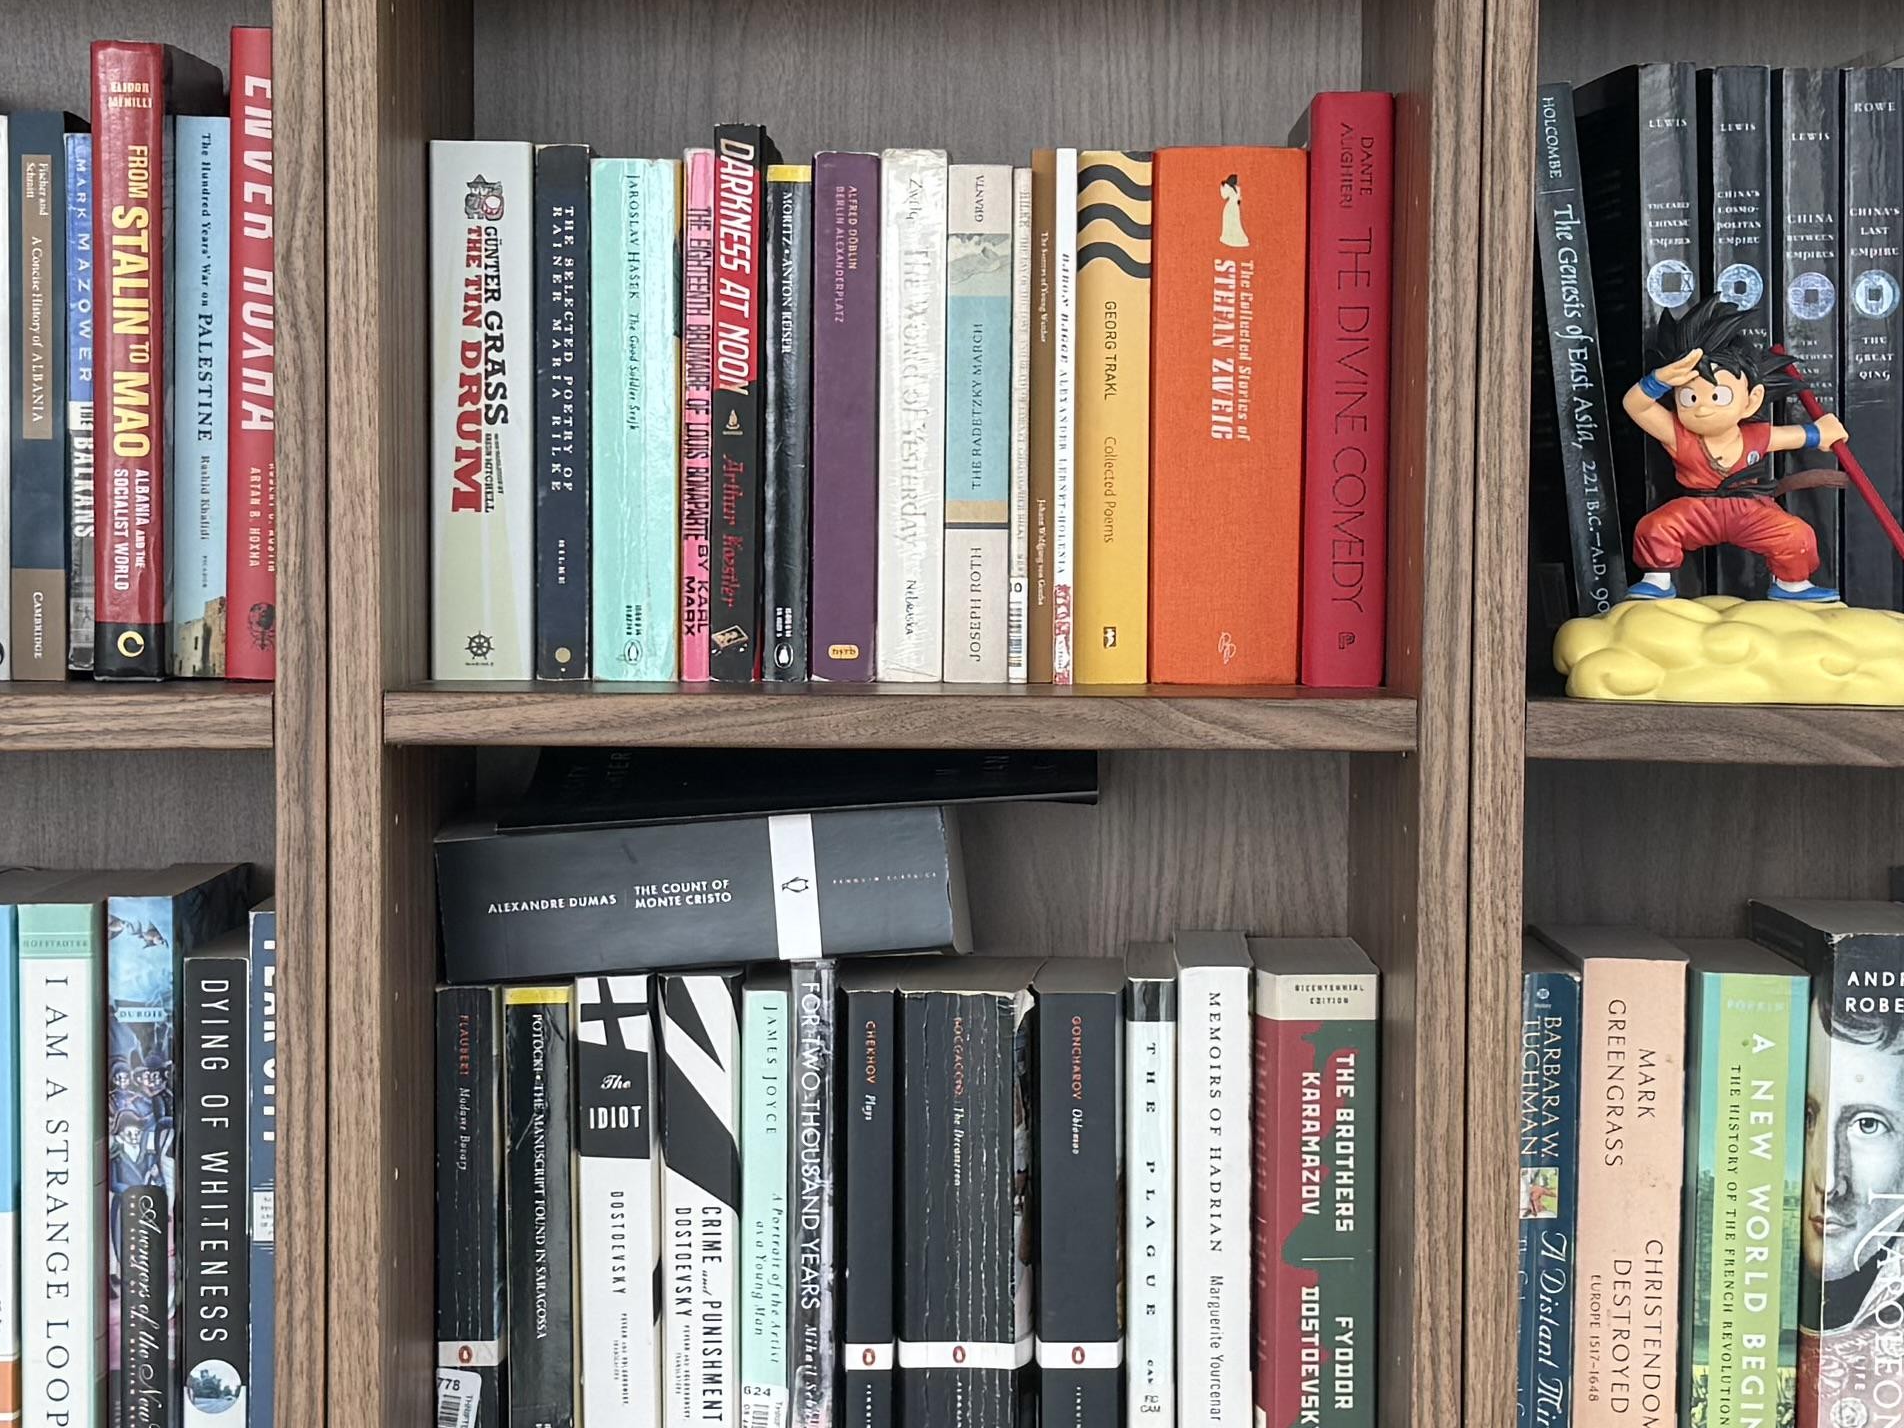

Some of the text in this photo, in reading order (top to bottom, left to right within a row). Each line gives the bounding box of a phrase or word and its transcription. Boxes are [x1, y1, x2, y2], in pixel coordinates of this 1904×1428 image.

[717, 138, 755, 396] DARKNESS AT NOON
[483, 225, 509, 426] GÜNTER GRASS
[451, 225, 483, 514] THE TIN DRUM
[634, 879, 730, 896] THE COUNT OF
[635, 889, 732, 908] MONTE CRISTO
[487, 893, 618, 914] ALEXANDRE DUMAS
[590, 1104, 641, 1131] IDIOT
